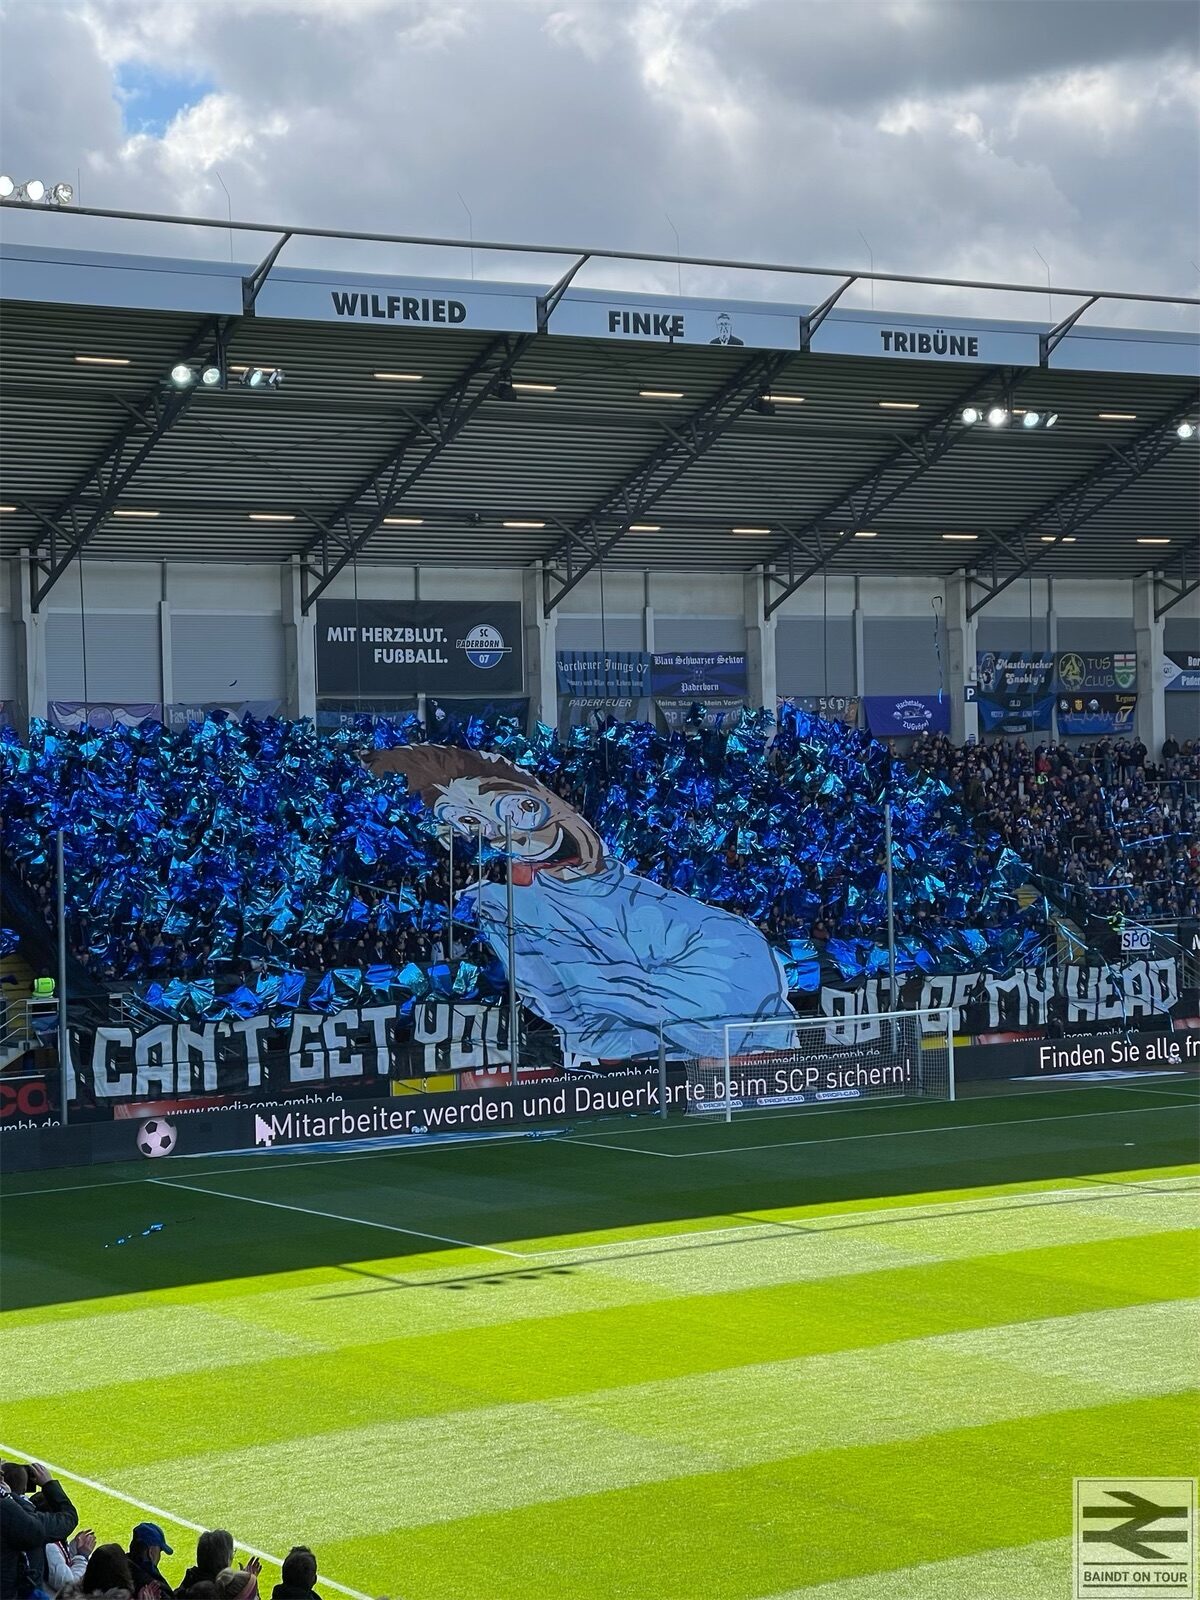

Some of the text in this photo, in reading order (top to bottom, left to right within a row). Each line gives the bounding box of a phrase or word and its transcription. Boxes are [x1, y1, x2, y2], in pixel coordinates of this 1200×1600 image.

[331, 291, 467, 324] WILFRIED
[608, 311, 685, 337] FINKE
[880, 329, 979, 357] TRIBÜNE
[327, 626, 448, 643] MIT HERZBLUT.
[479, 628, 489, 637] SC
[456, 639, 500, 648] PADERBORN
[374, 648, 448, 664] FUßBALL.
[479, 654, 490, 664] 07
[653, 654, 744, 666] Blau Schwarzer Sektor
[1087, 656, 1111, 670] TUS
[604, 658, 634, 673] Jungs
[636, 663, 649, 674] 07
[681, 683, 719, 692] Paderborn
[1084, 674, 1115, 688] CLUB
[967, 688, 975, 700] P
[568, 698, 633, 708] PADERFEUER
[92, 1015, 270, 1097] CAN'T
[288, 1005, 397, 1083] GET
[413, 1003, 520, 1073] YOU
[919, 971, 981, 1033] OF
[983, 966, 1056, 1028] MY
[1066, 957, 1179, 1023] HEAD
[1040, 1043, 1105, 1069] Finden
[1110, 1039, 1140, 1063] Sie
[1145, 1037, 1180, 1060] alle
[272, 1059, 911, 1139] Mitarbeiter werden und Dauerkarte beim SCP sichern!
